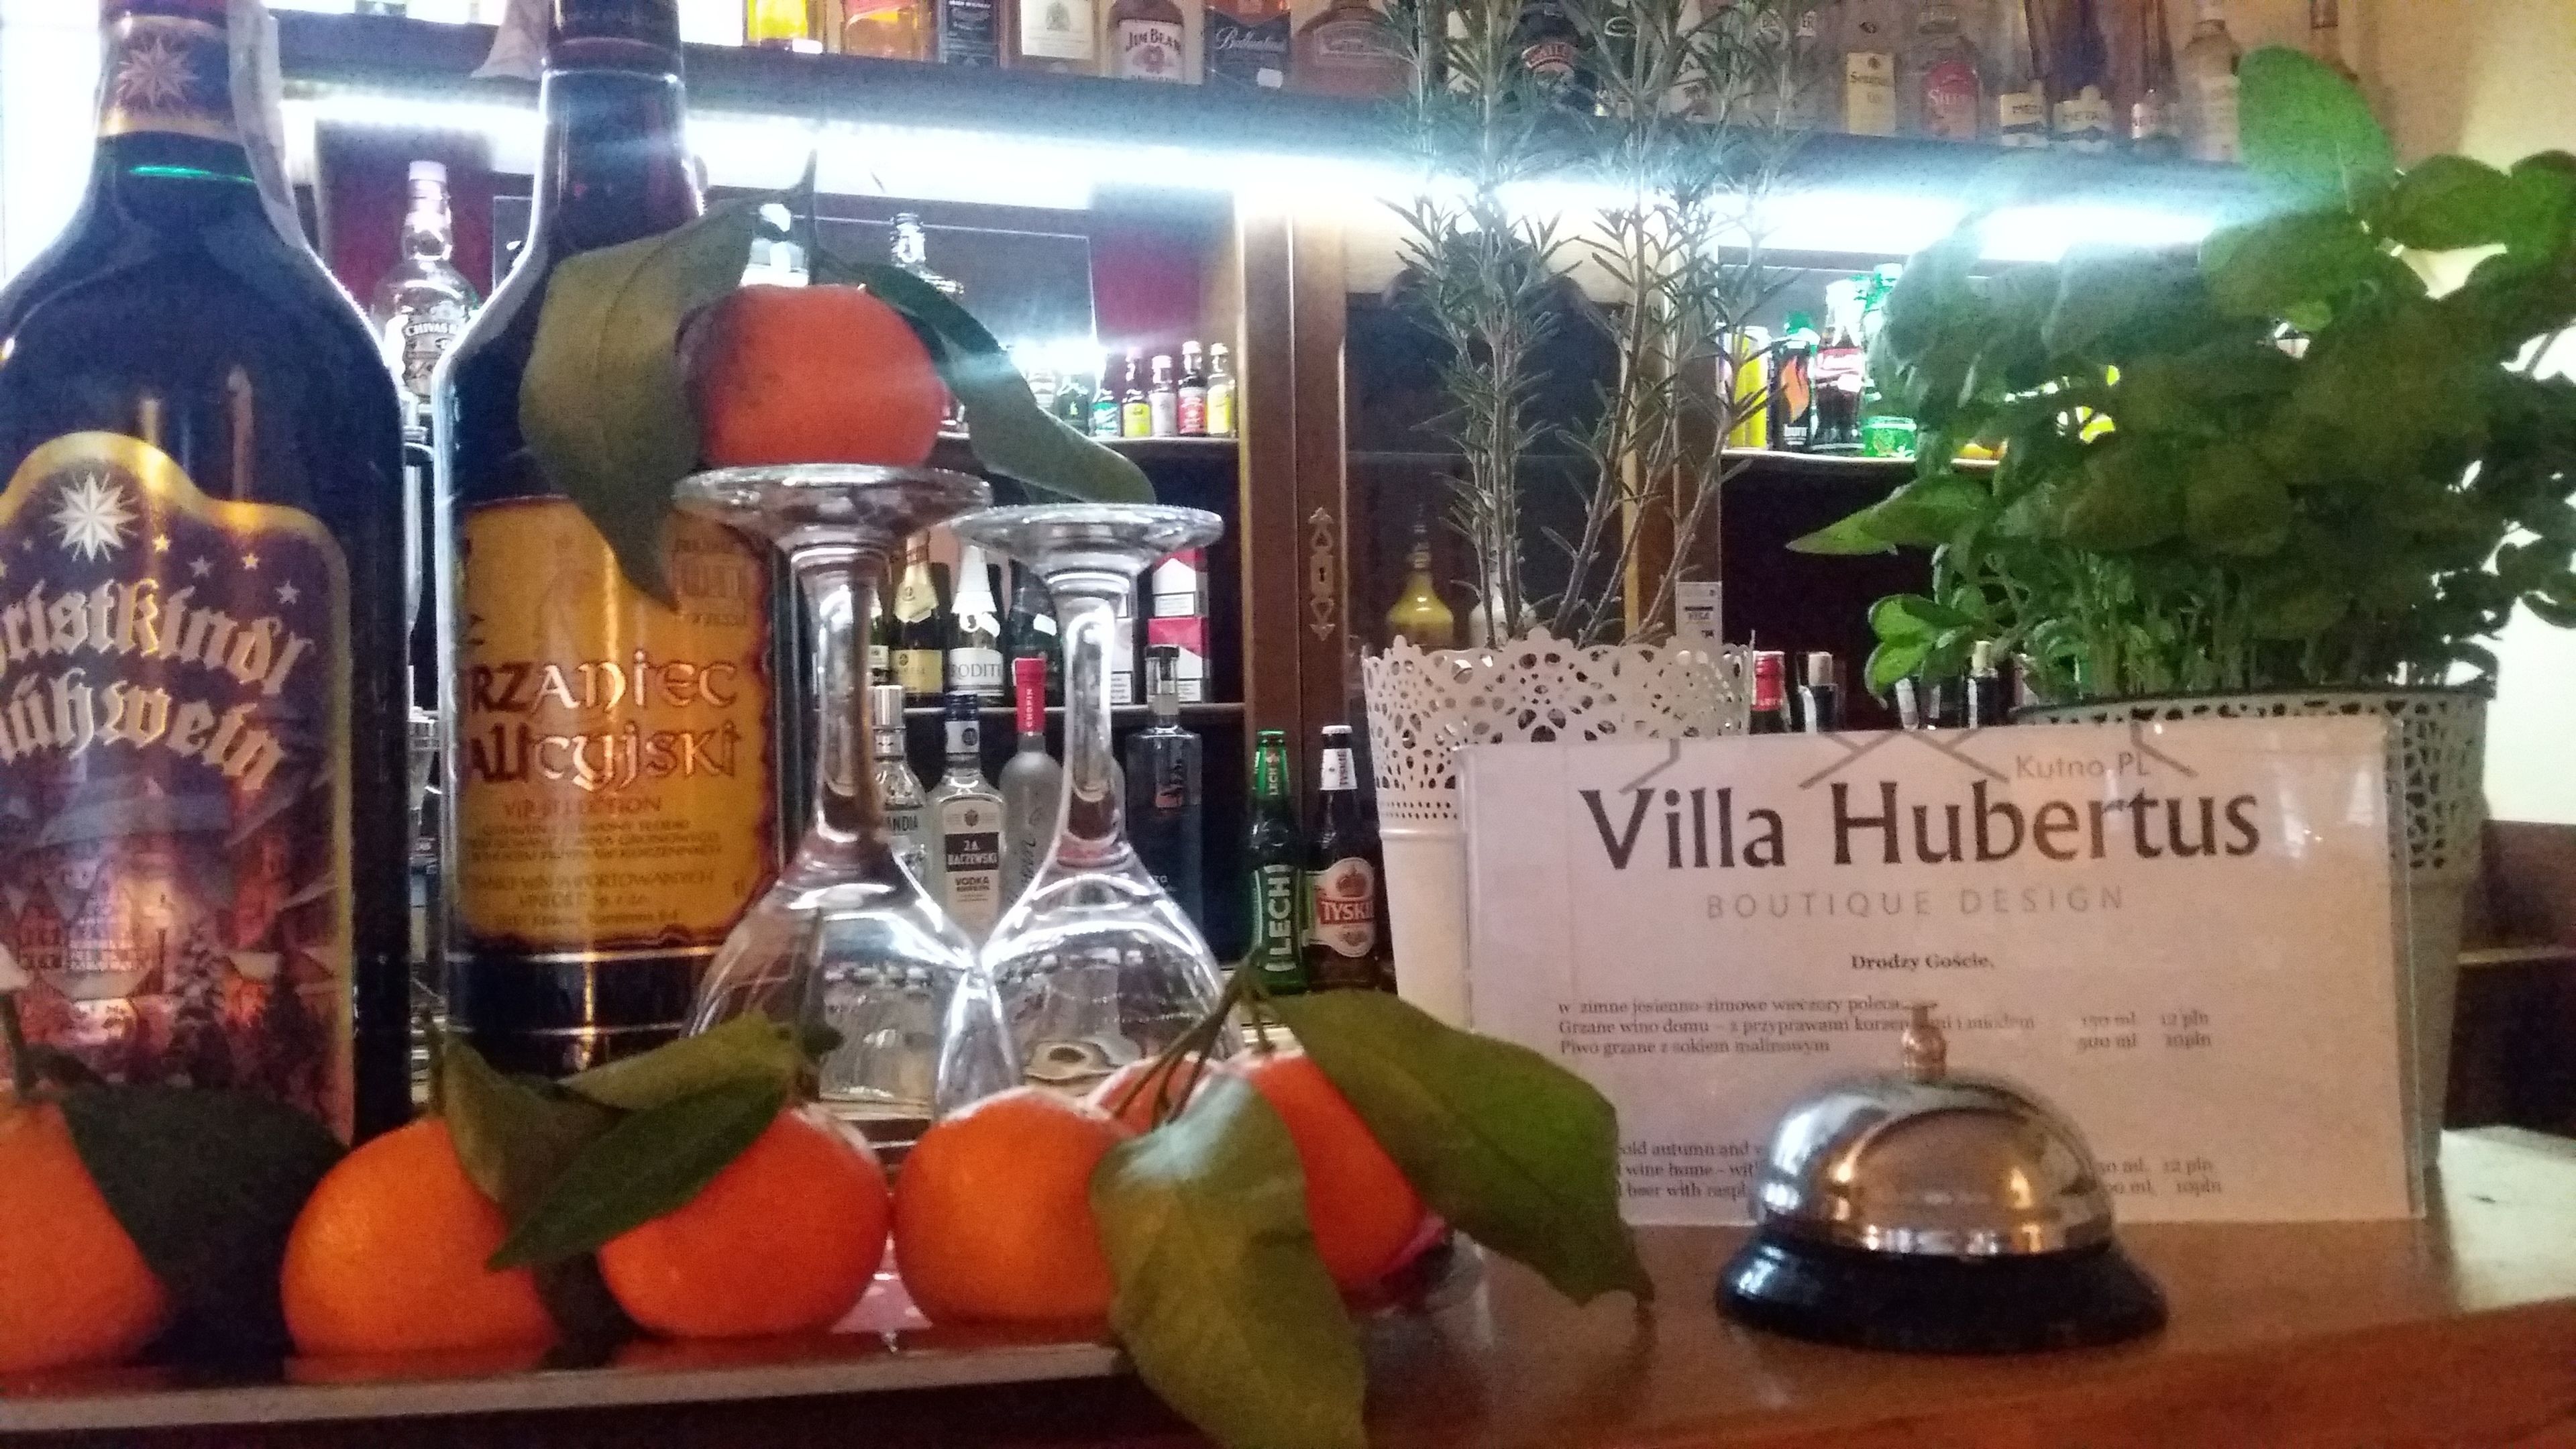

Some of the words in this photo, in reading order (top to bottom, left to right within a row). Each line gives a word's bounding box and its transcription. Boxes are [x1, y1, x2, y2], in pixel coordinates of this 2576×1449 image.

[1126, 32, 1147, 52] JIM
[405, 322, 449, 336] CHIVAS
[0, 577, 317, 695] ristkindl
[1026, 688, 1034, 728] CHOPIN
[2017, 753, 2104, 781] Kutno
[2119, 751, 2152, 777] PL
[1578, 786, 1787, 871] Villa
[1829, 779, 2261, 867] Hubertus
[947, 853, 998, 865] BACZEWSKI
[955, 876, 990, 886] VODKA
[1707, 889, 1931, 920] BOUTIQUE
[1961, 885, 2123, 914] DESIGN
[1268, 876, 1292, 955] LECH
[1851, 953, 1919, 972] Drodzy
[1580, 1000, 1627, 1014] zimne
[1848, 995, 1900, 1016] poleca
[1558, 1019, 1615, 1034] Grzane
[1620, 1019, 1659, 1033] wino
[1663, 1017, 1709, 1033] domu
[2114, 1011, 2136, 1026] ml
[2182, 1009, 2209, 1030] pln
[1560, 1039, 1600, 1055] Piwo
[1603, 1042, 1656, 1058] grzane
[1674, 1038, 1730, 1053] sokiem
[1735, 1038, 1831, 1056] malinowym
[2115, 1032, 2137, 1048] ml
[1652, 1143, 1715, 1157] autumn
[1719, 1140, 1749, 1157] and
[1625, 1164, 1664, 1176] wine
[2186, 1157, 2213, 1176] pln
[1627, 1182, 1660, 1197] beer
[1666, 1180, 1702, 1197] with
